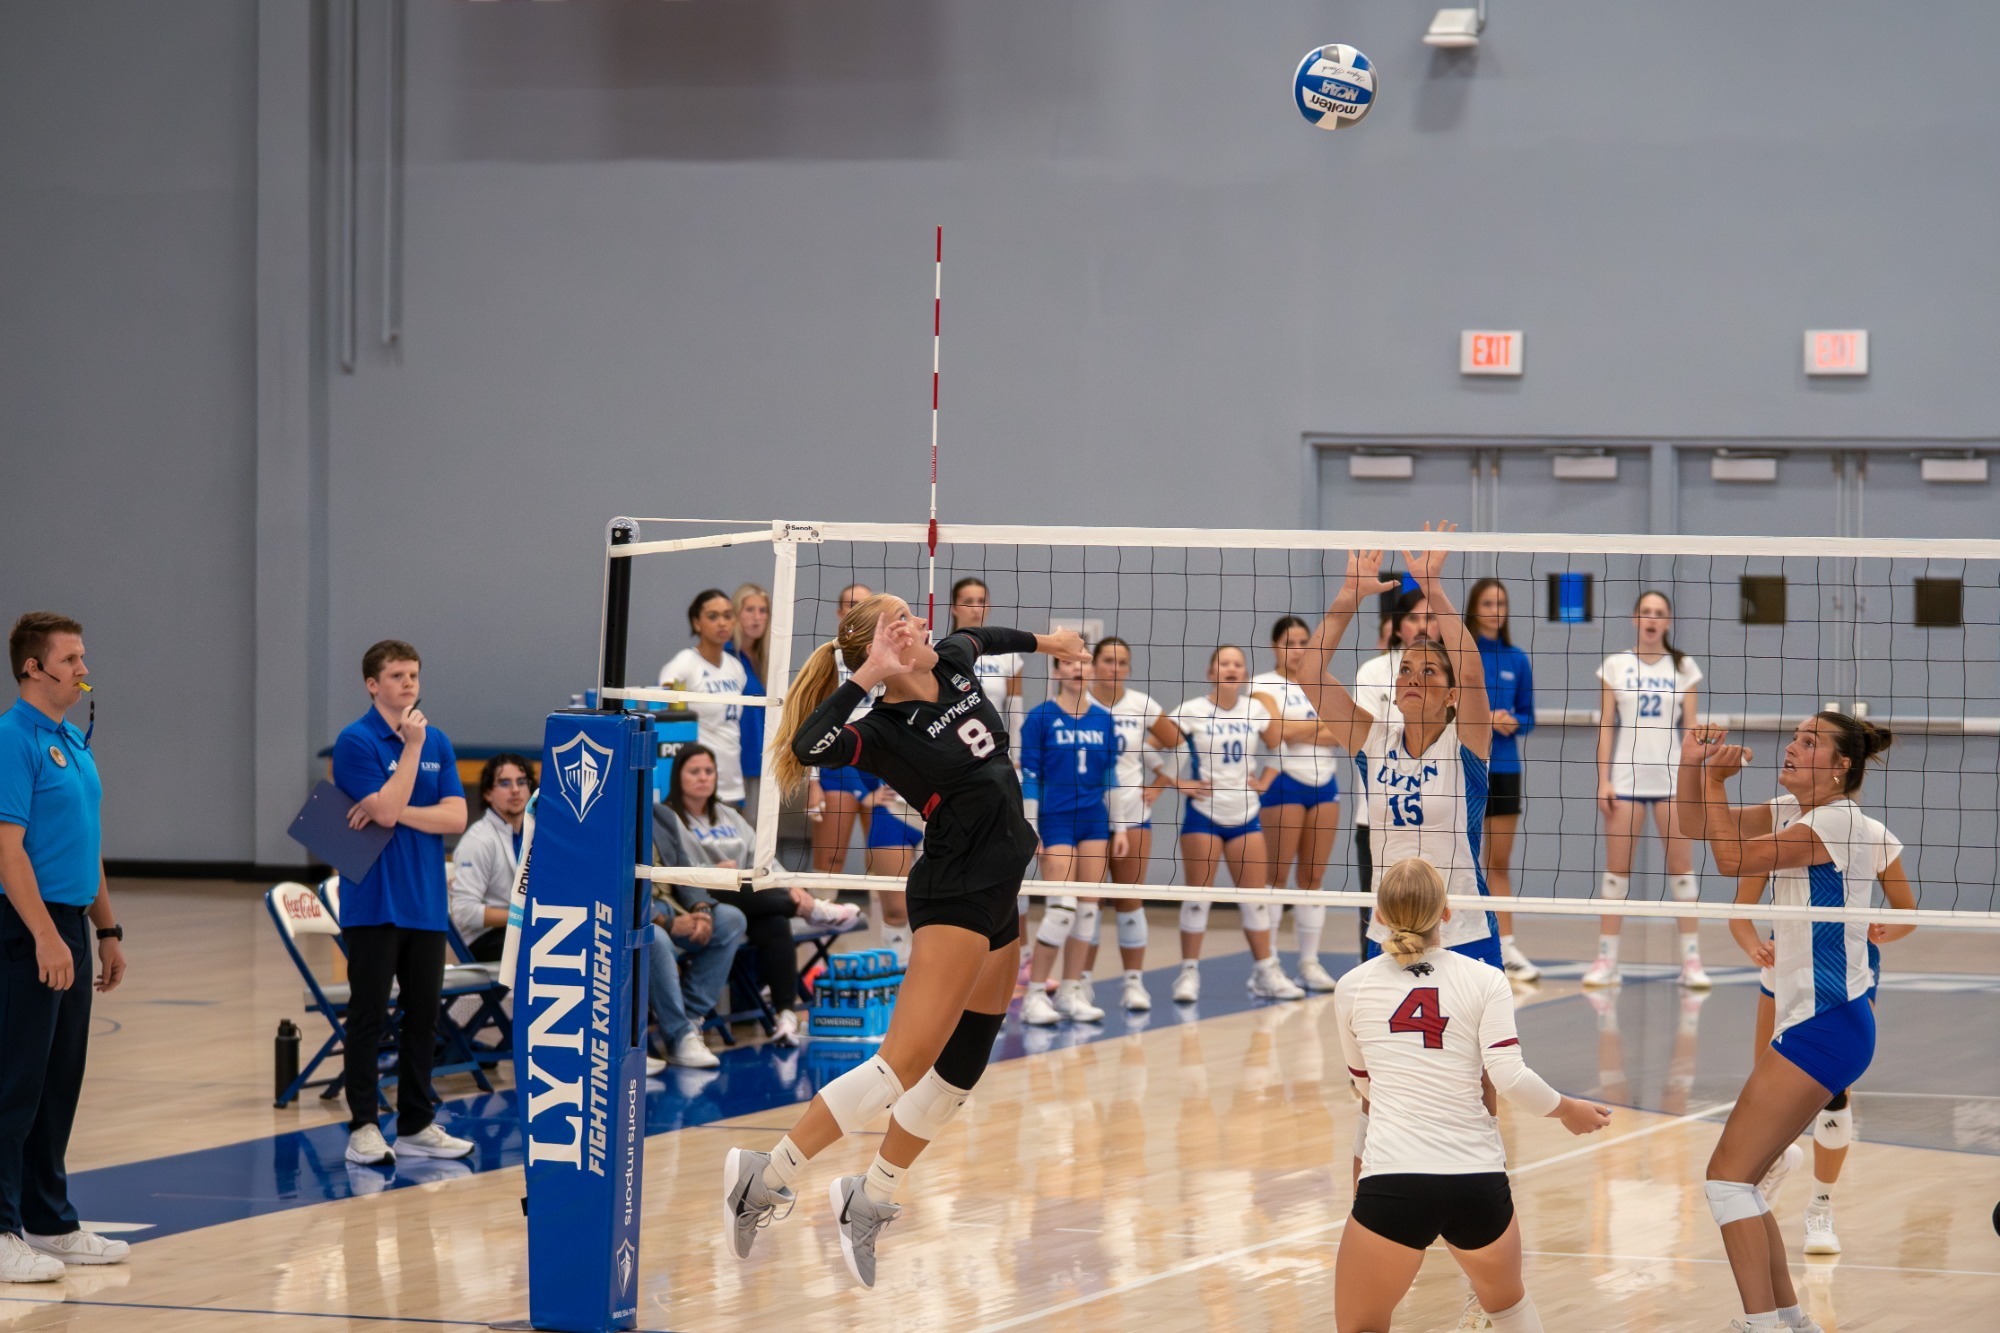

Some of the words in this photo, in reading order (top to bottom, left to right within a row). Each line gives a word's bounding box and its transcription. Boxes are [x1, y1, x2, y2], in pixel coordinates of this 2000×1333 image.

[1311, 94, 1358, 115] molten
[1321, 79, 1359, 102] NCAA
[1473, 335, 1512, 367] EXIT
[1816, 334, 1857, 368] EXIT
[1626, 678, 1674, 689] LYNN
[926, 692, 982, 738] PANTHERS
[1640, 694, 1662, 717] 22
[957, 718, 996, 759] 8
[1056, 730, 1104, 745] LYNN
[1206, 723, 1254, 735] LYNN
[1077, 747, 1088, 774] 1
[1222, 740, 1242, 763] 10
[1377, 760, 1438, 792] LYNN
[1389, 792, 1424, 826] 15
[591, 900, 613, 1035] KNIGHTS
[527, 897, 588, 1170] LYNN
[815, 1016, 862, 1026] POWERADE
[1388, 987, 1450, 1049] 4
[588, 1037, 610, 1177] FIGHTING
[628, 1078, 637, 1143] sports
[624, 1146, 634, 1226] imports
